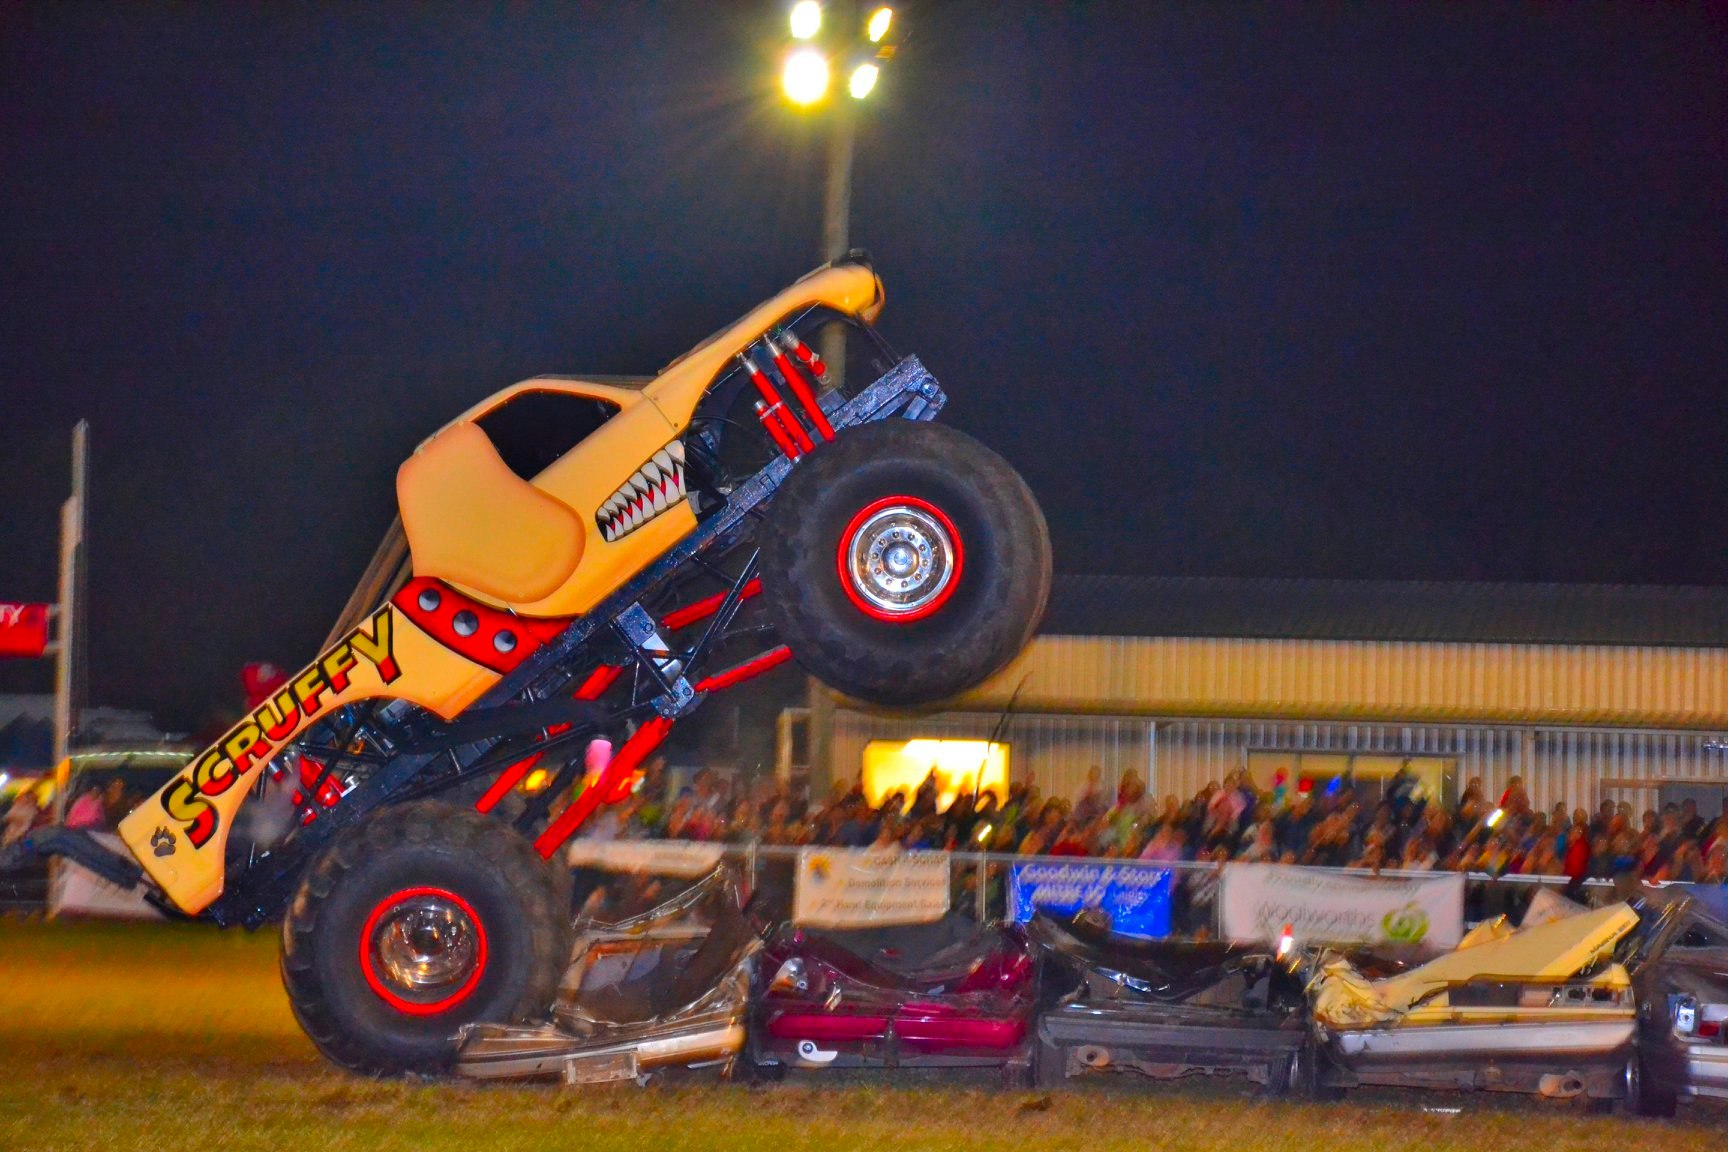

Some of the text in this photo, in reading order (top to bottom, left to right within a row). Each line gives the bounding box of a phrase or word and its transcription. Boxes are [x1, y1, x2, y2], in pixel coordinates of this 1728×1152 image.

[160, 604, 402, 849] SCRUFFY
[848, 878, 901, 888] Demolition
[1020, 863, 1099, 883] Goodwin
